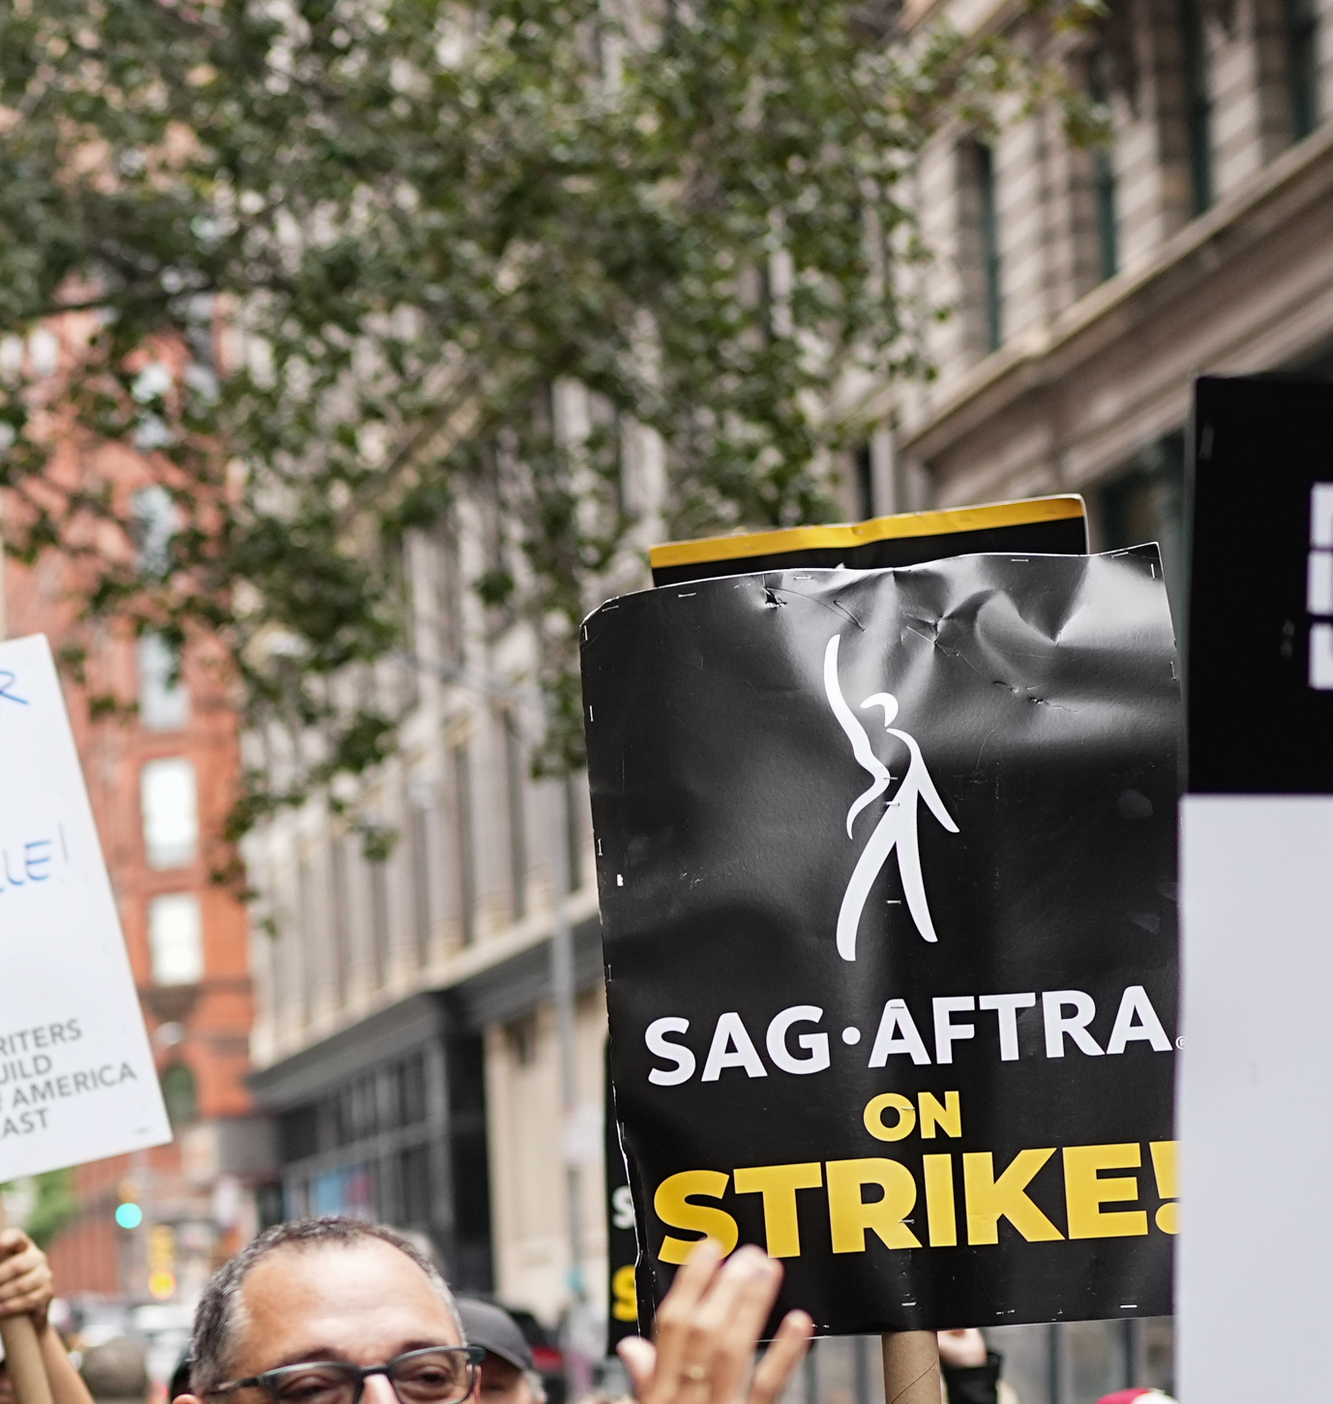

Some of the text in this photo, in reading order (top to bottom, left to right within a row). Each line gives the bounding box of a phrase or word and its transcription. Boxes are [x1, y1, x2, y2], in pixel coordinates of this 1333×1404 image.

[12, 1061, 139, 1109] AMERICA
[862, 1090, 963, 1144] ON
[651, 1138, 1181, 1267] STRIKE!
